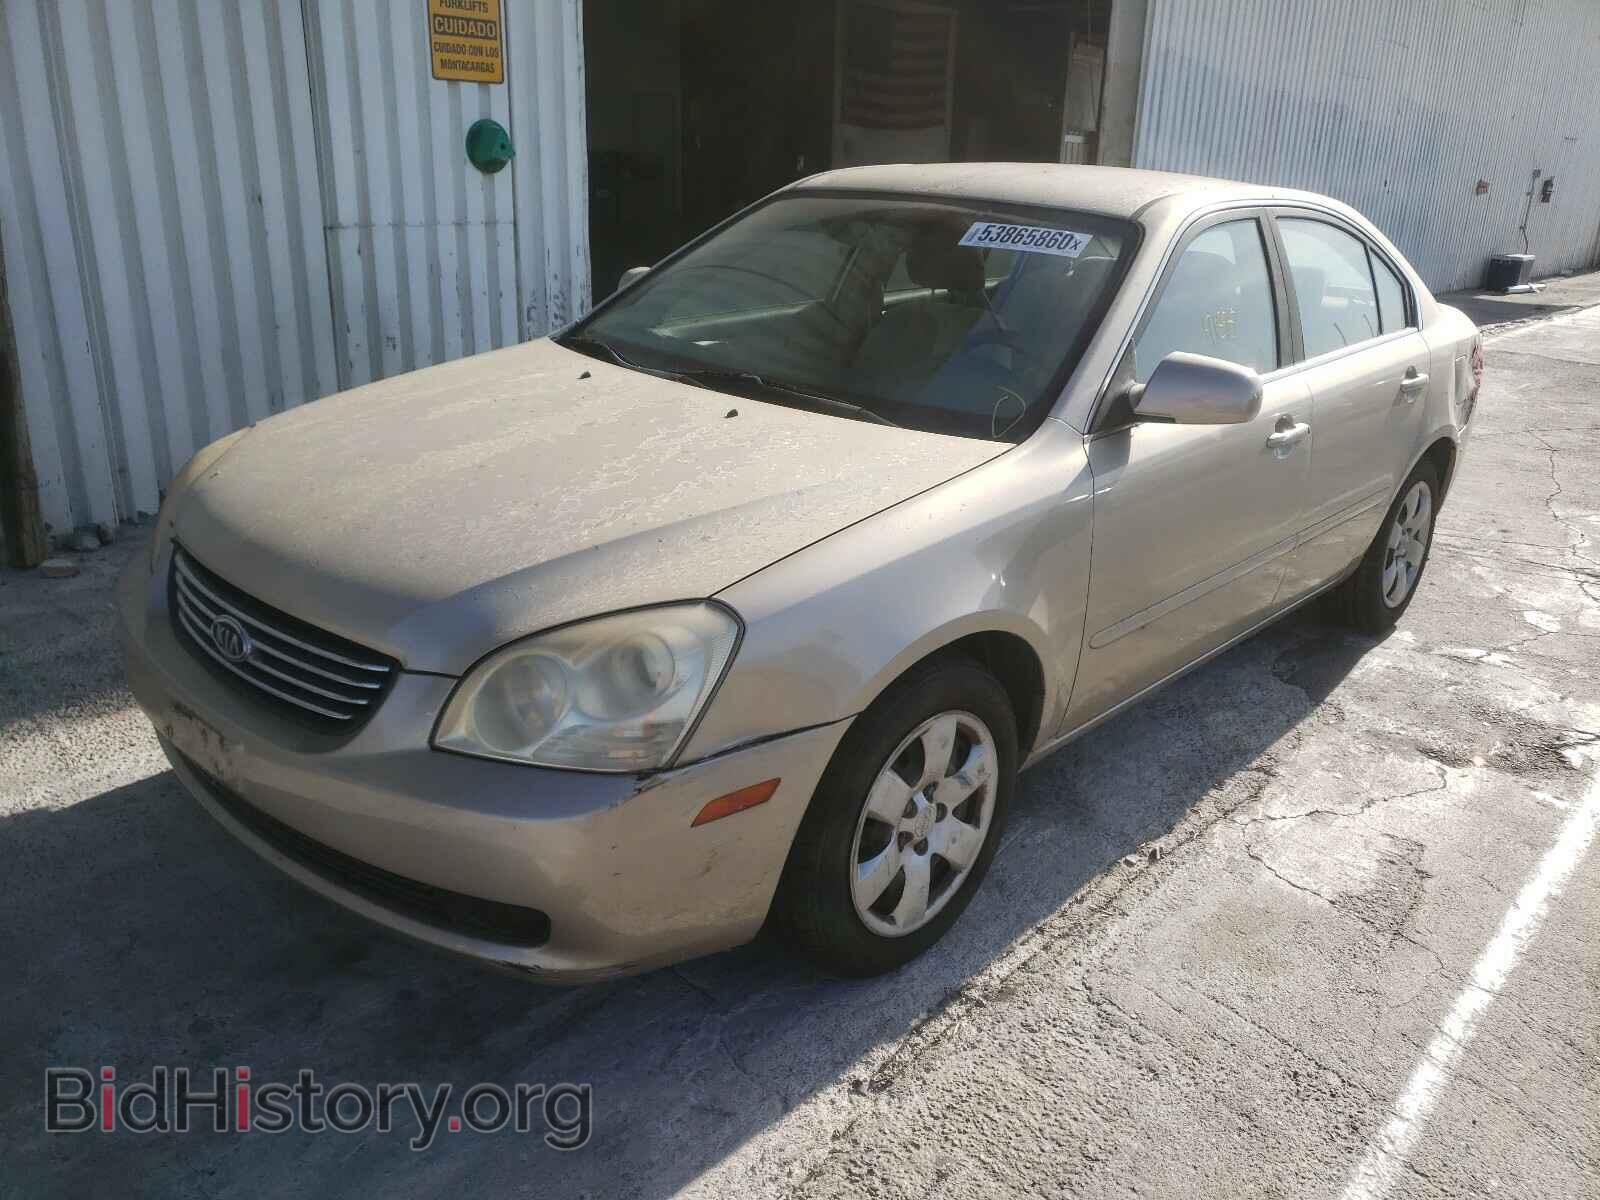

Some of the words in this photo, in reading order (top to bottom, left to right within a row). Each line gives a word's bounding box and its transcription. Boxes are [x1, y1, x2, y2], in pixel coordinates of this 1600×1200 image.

[434, 16, 496, 37] CUIDADO
[433, 41, 466, 56] CUIDADO
[468, 45, 483, 57] CON
[485, 47, 499, 58] LOS
[440, 58, 495, 73] MONTACARGAS
